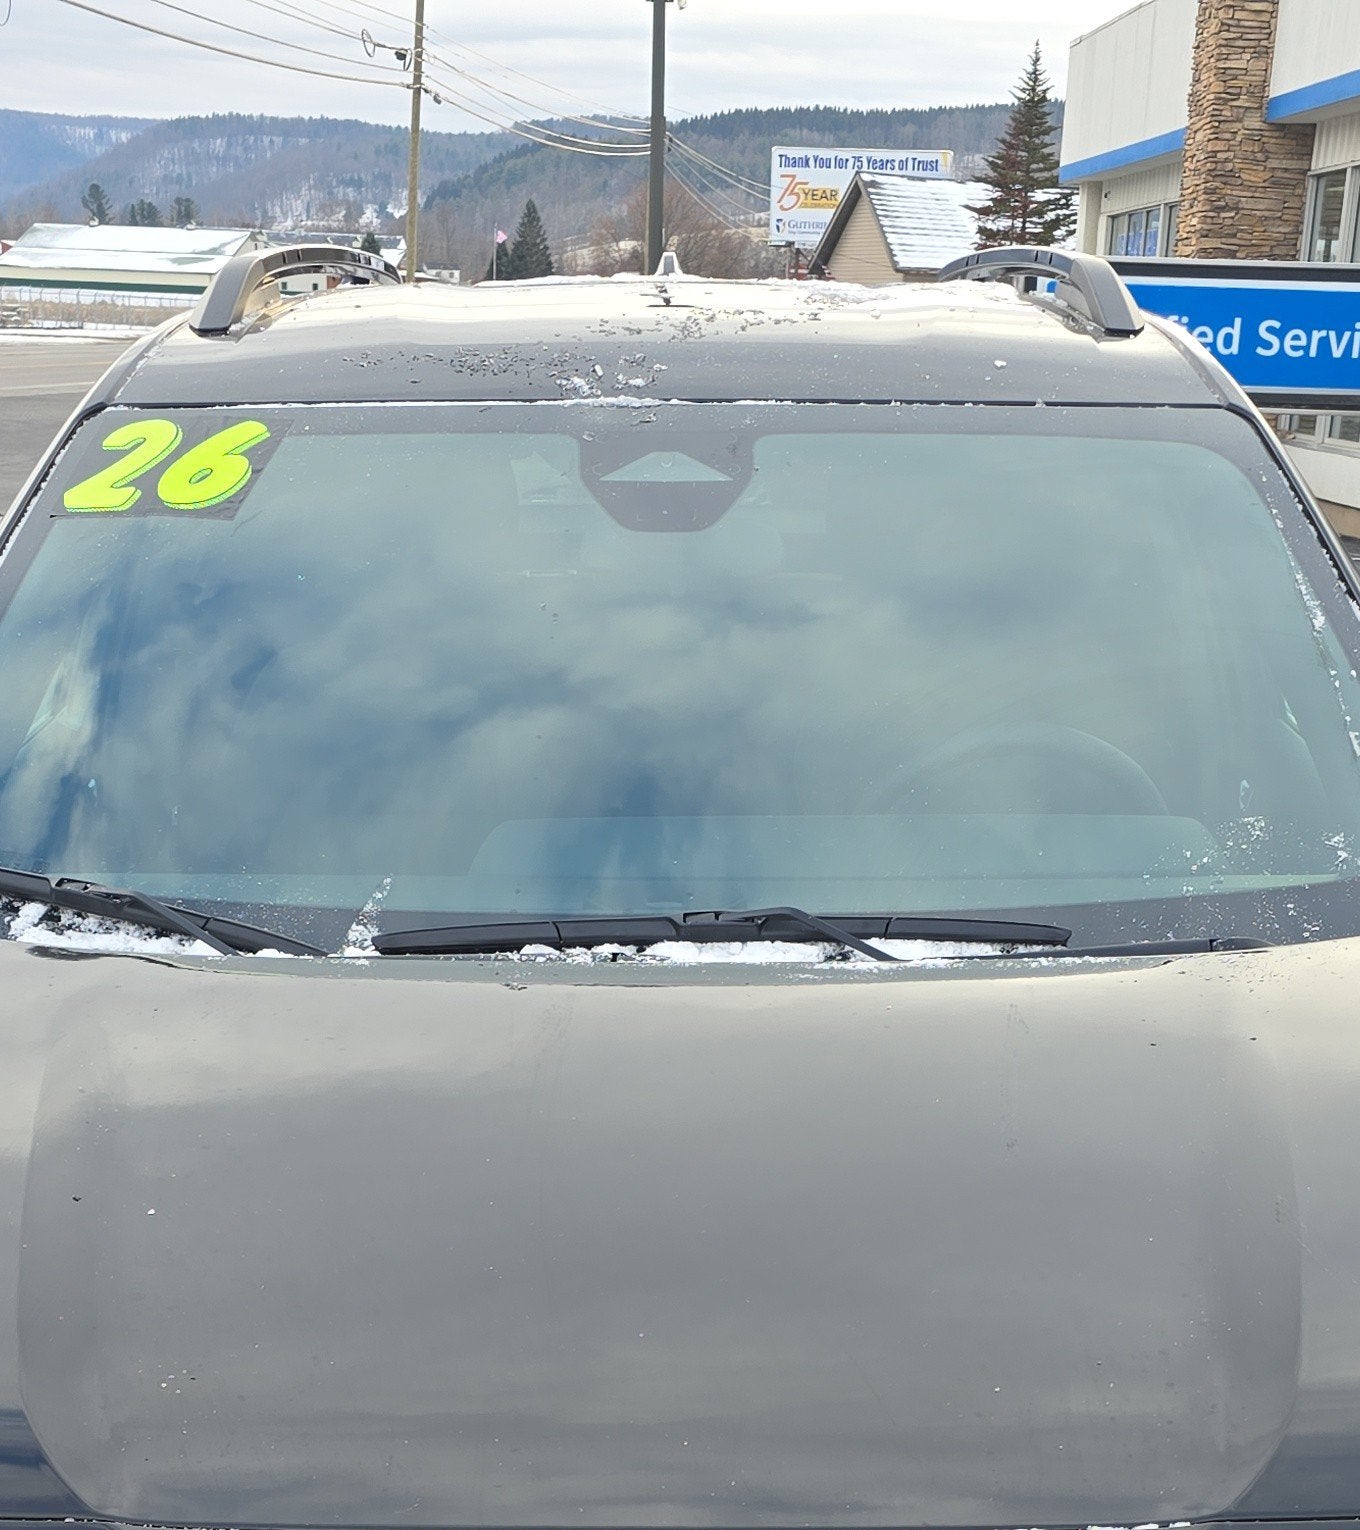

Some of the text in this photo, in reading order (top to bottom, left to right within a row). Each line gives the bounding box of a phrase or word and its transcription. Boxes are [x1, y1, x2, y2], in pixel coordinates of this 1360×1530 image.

[778, 154, 939, 172] Thank You for 75 Years of Trust
[777, 174, 839, 211] 75 YEAR
[63, 419, 271, 513] 26
